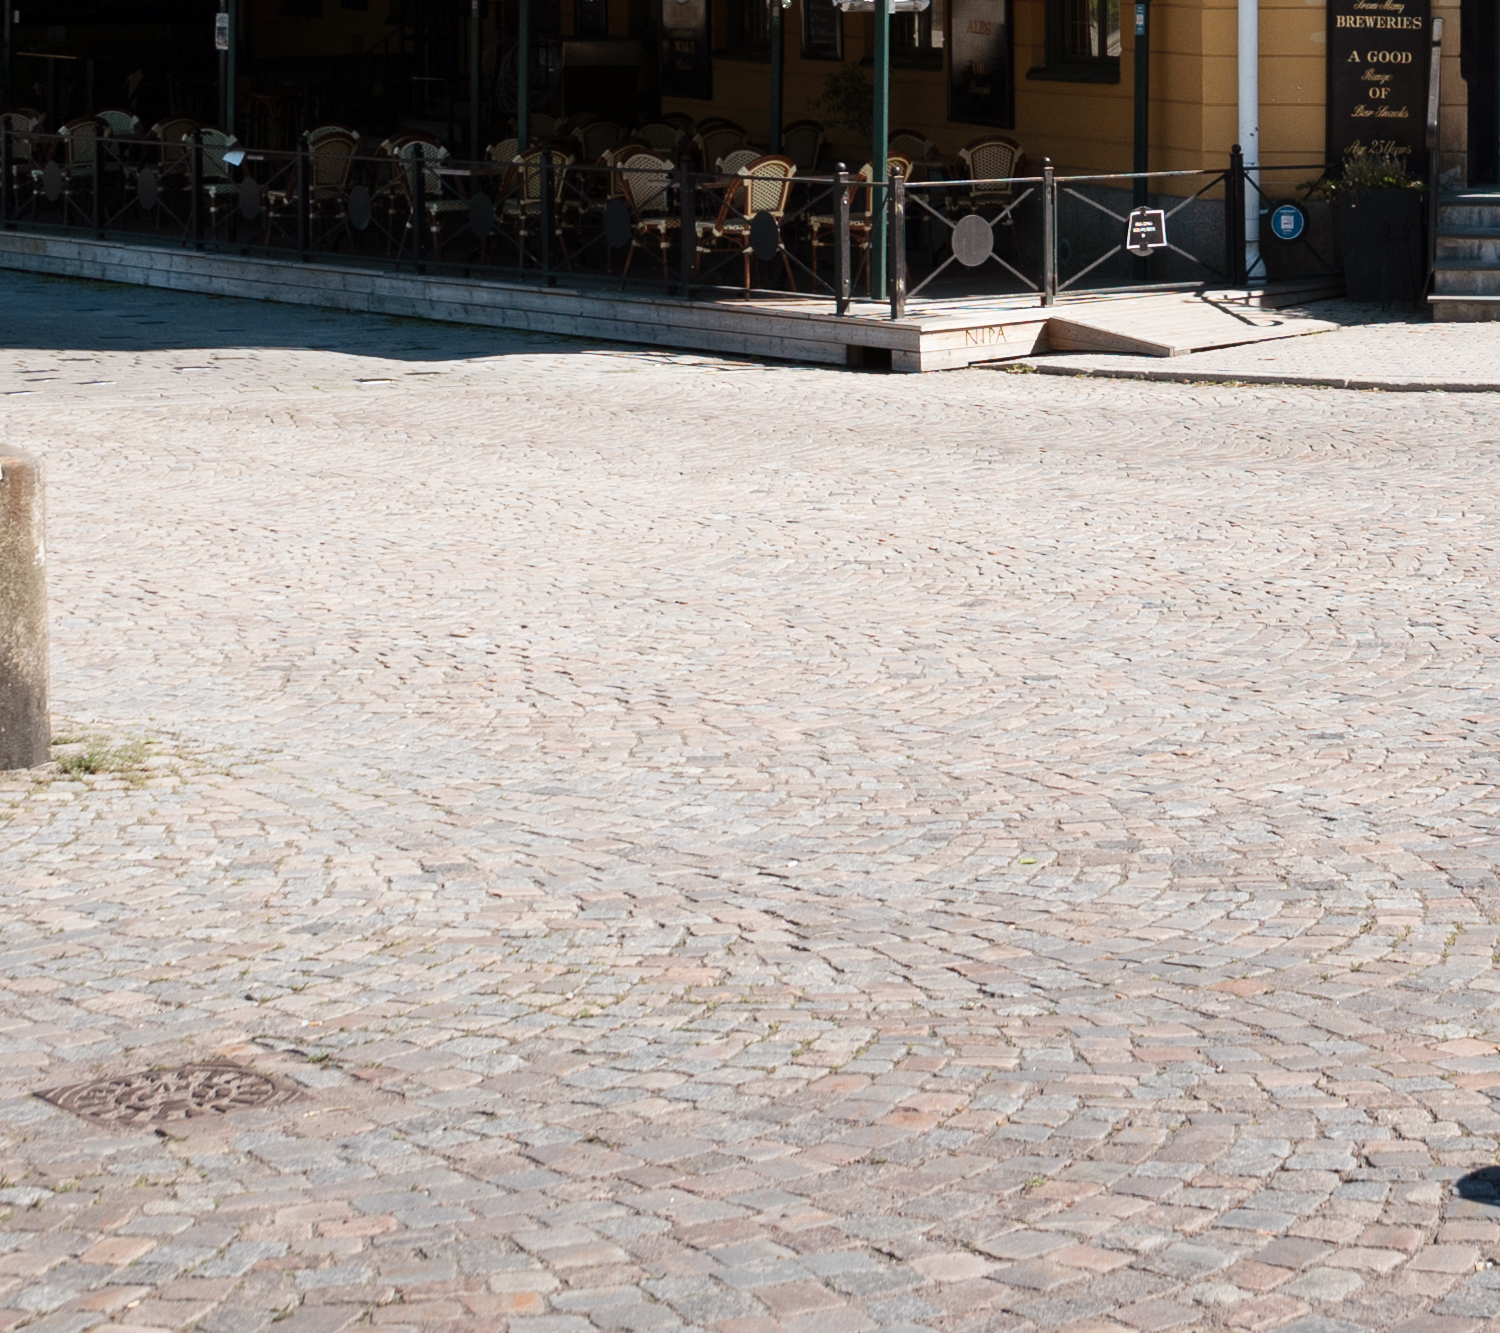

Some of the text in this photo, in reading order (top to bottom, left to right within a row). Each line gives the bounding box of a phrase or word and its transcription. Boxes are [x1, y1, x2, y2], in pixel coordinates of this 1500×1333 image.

[1336, 15, 1422, 30] BREWERIES
[1347, 50, 1412, 64] A GOOD
[1368, 87, 1391, 99] OF
